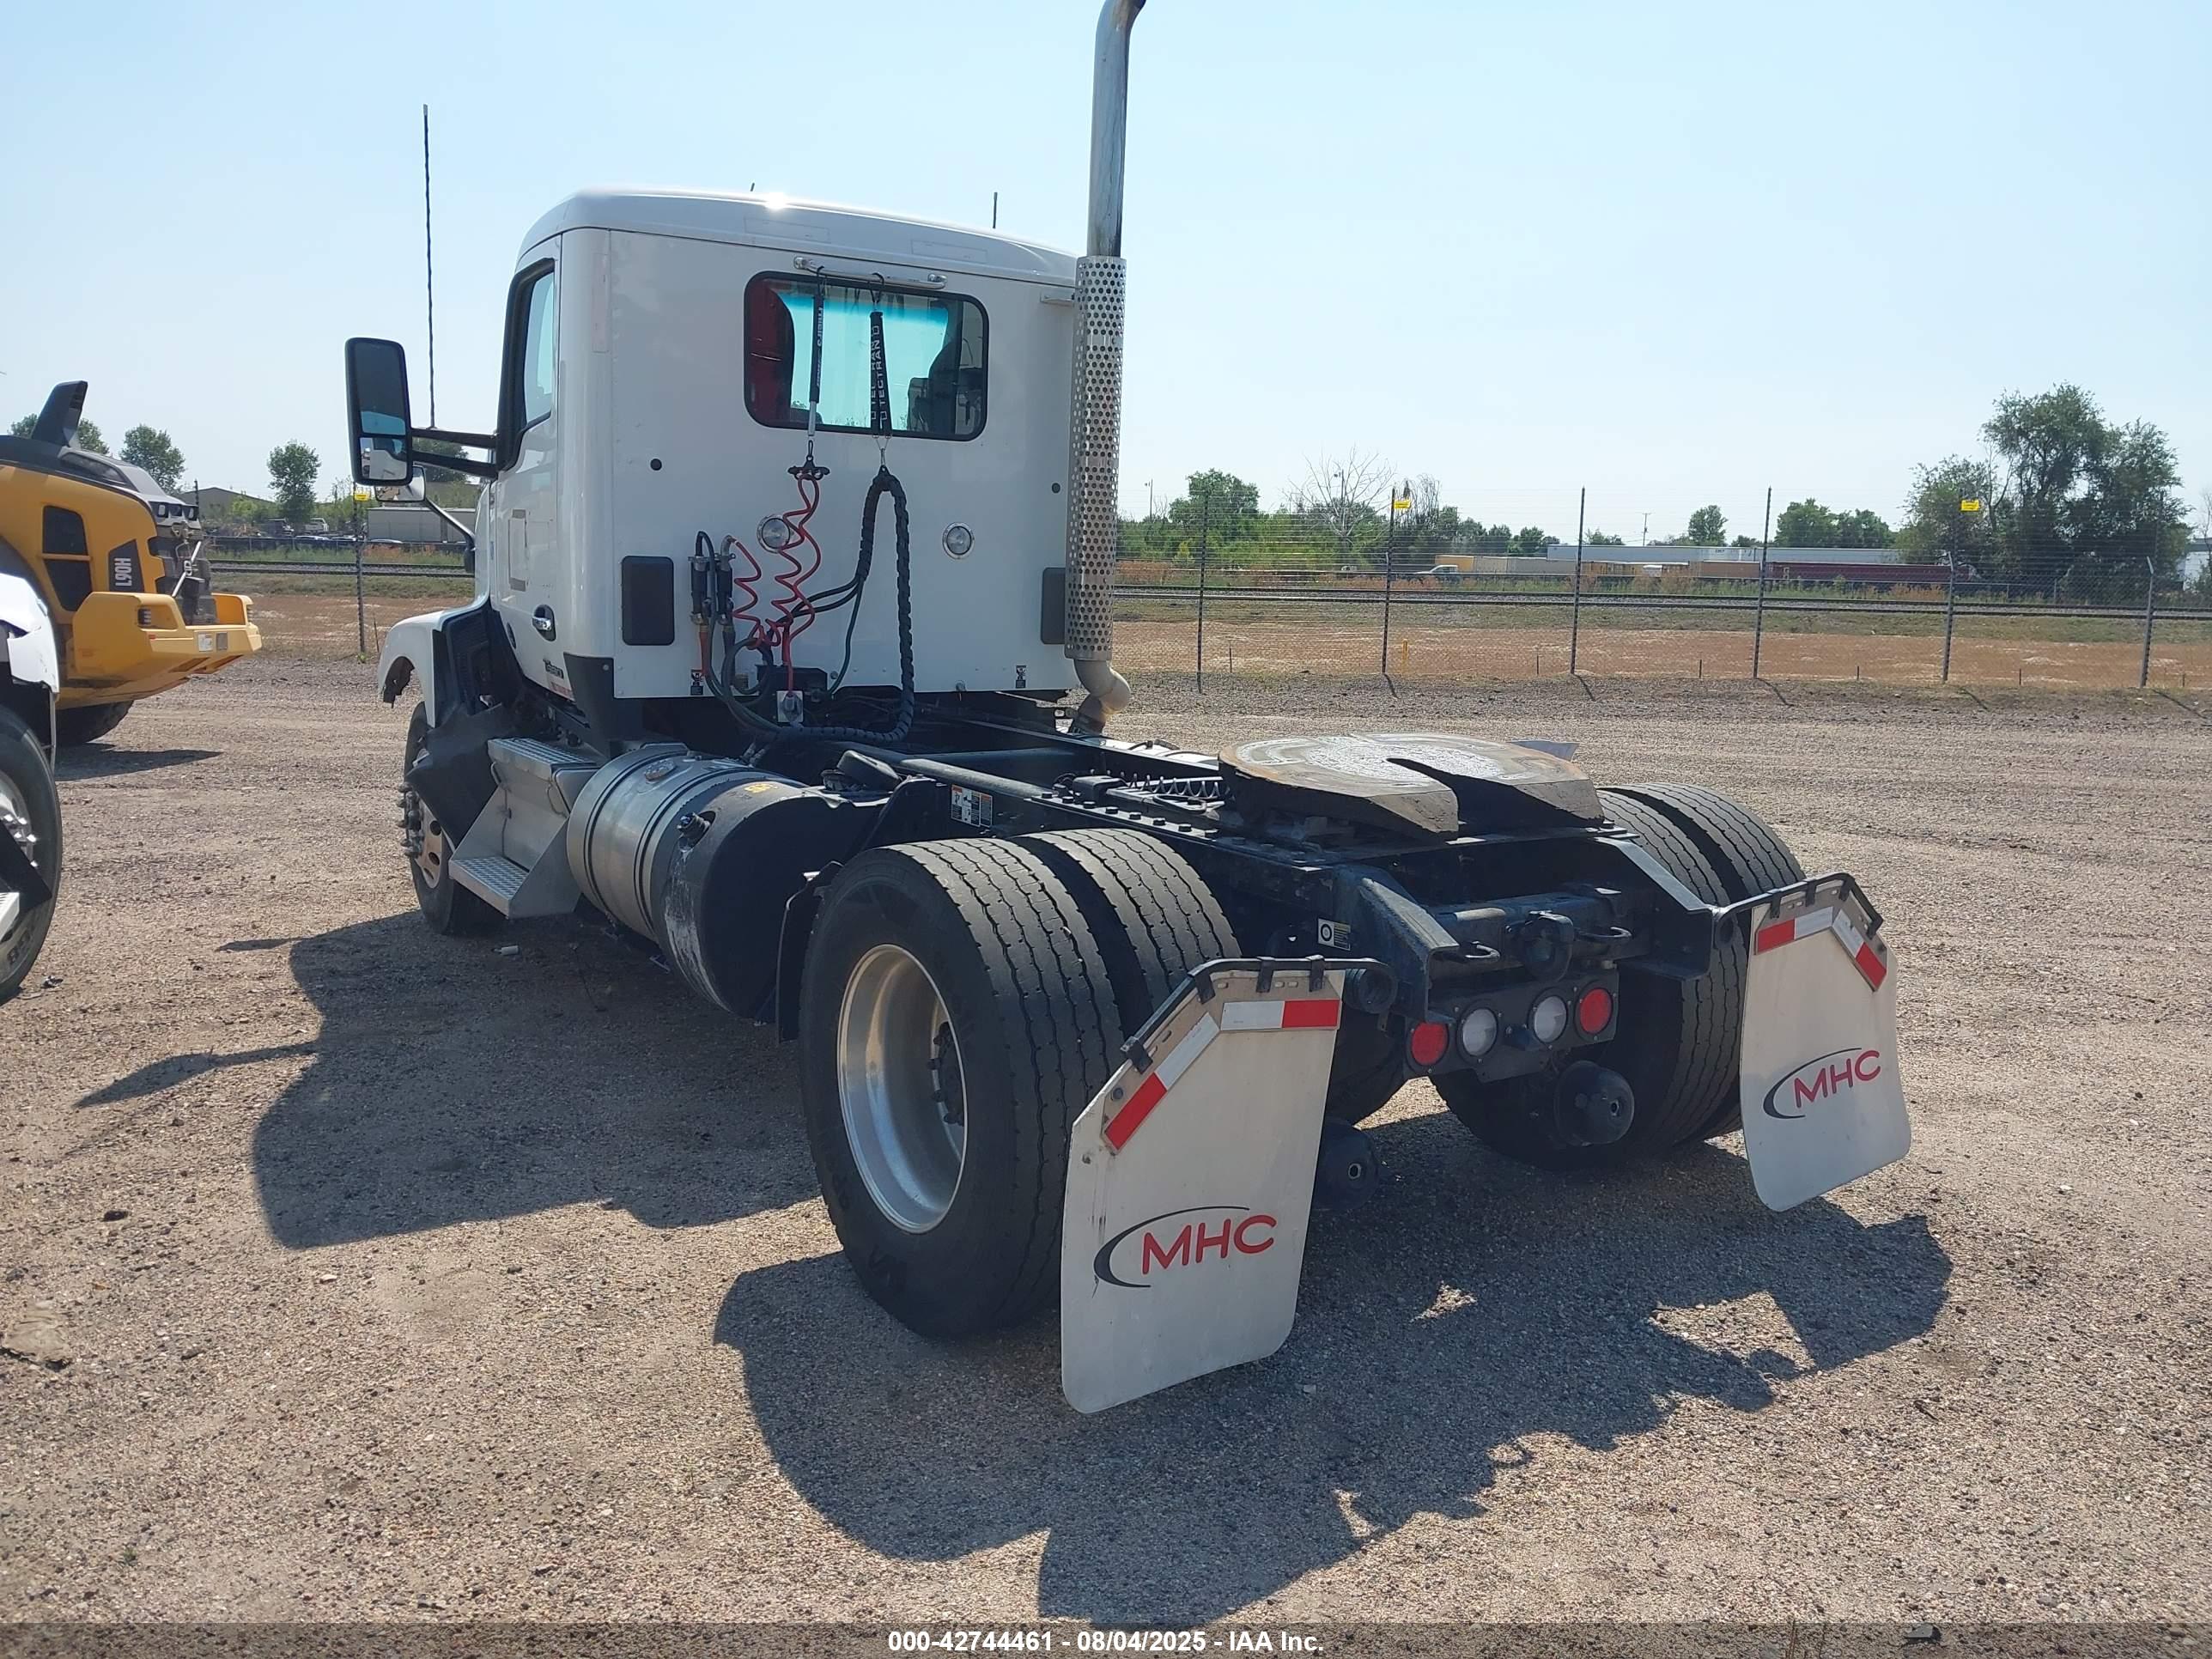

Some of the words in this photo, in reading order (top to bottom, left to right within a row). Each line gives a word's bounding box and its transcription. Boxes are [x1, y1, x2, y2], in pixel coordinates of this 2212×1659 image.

[875, 339, 886, 407] TECTRAN
[114, 557, 132, 586] L90H
[1794, 1049, 1881, 1109] MHC
[1142, 1214, 1277, 1275] MHC
